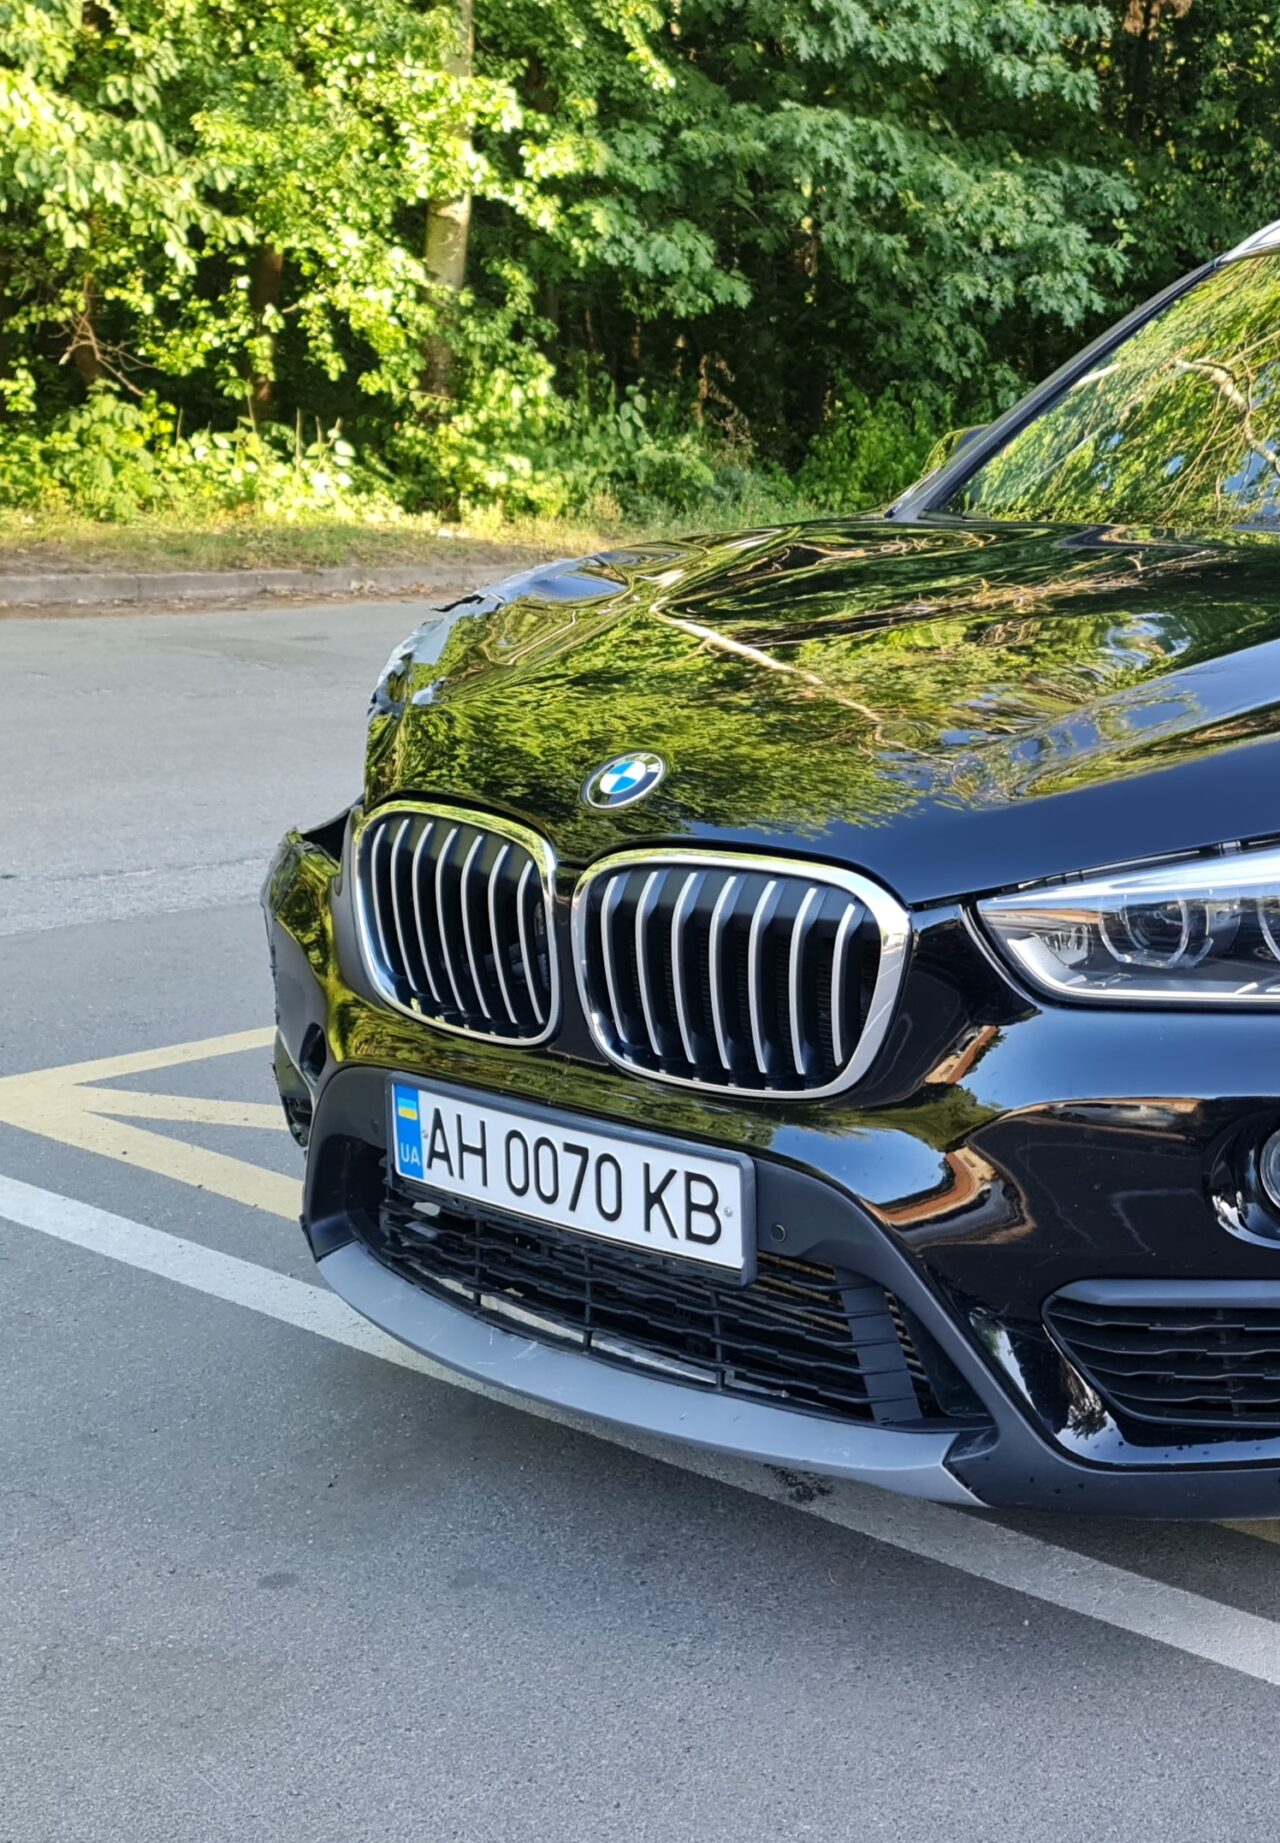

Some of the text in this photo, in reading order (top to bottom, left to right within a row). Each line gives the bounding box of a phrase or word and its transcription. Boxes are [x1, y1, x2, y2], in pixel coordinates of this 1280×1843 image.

[400, 1142, 421, 1167] UA
[426, 1107, 722, 1246] AH 0070 KB
